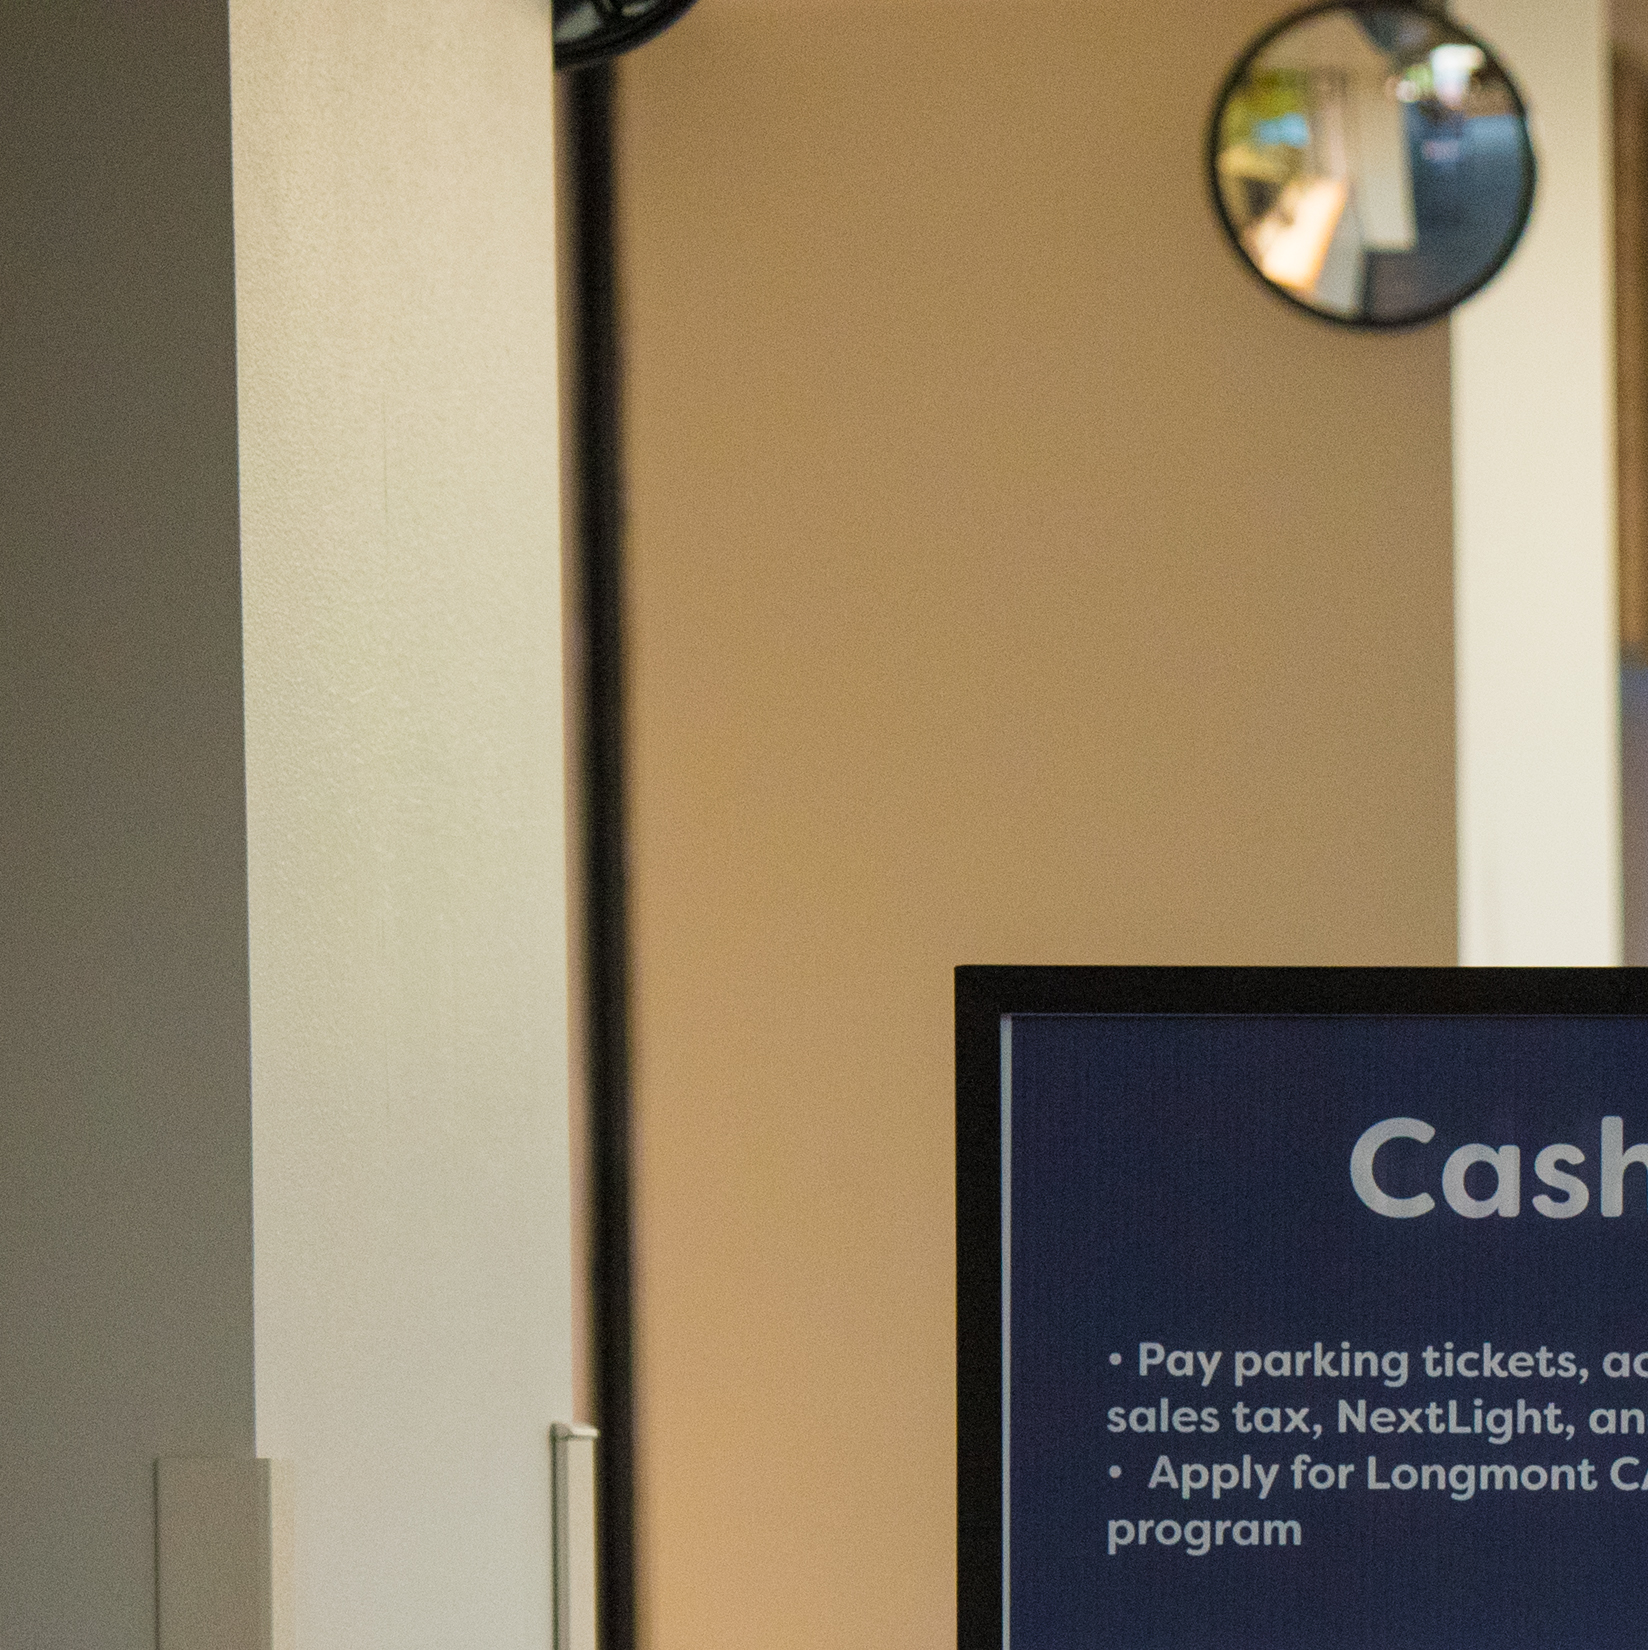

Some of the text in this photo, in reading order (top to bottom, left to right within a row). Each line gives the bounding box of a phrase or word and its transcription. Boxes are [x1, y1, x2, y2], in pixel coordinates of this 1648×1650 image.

[1137, 1340, 1224, 1388] Pay
[1233, 1339, 1411, 1389] parking
[1420, 1340, 1591, 1385] tickets,
[1106, 1396, 1221, 1435] sales
[1231, 1400, 1324, 1440] tax,
[1336, 1396, 1577, 1447] NextLight,
[1147, 1453, 1281, 1501] Apply
[1289, 1452, 1357, 1491] for
[1365, 1454, 1600, 1503] Longmont
[1106, 1517, 1303, 1558] program
